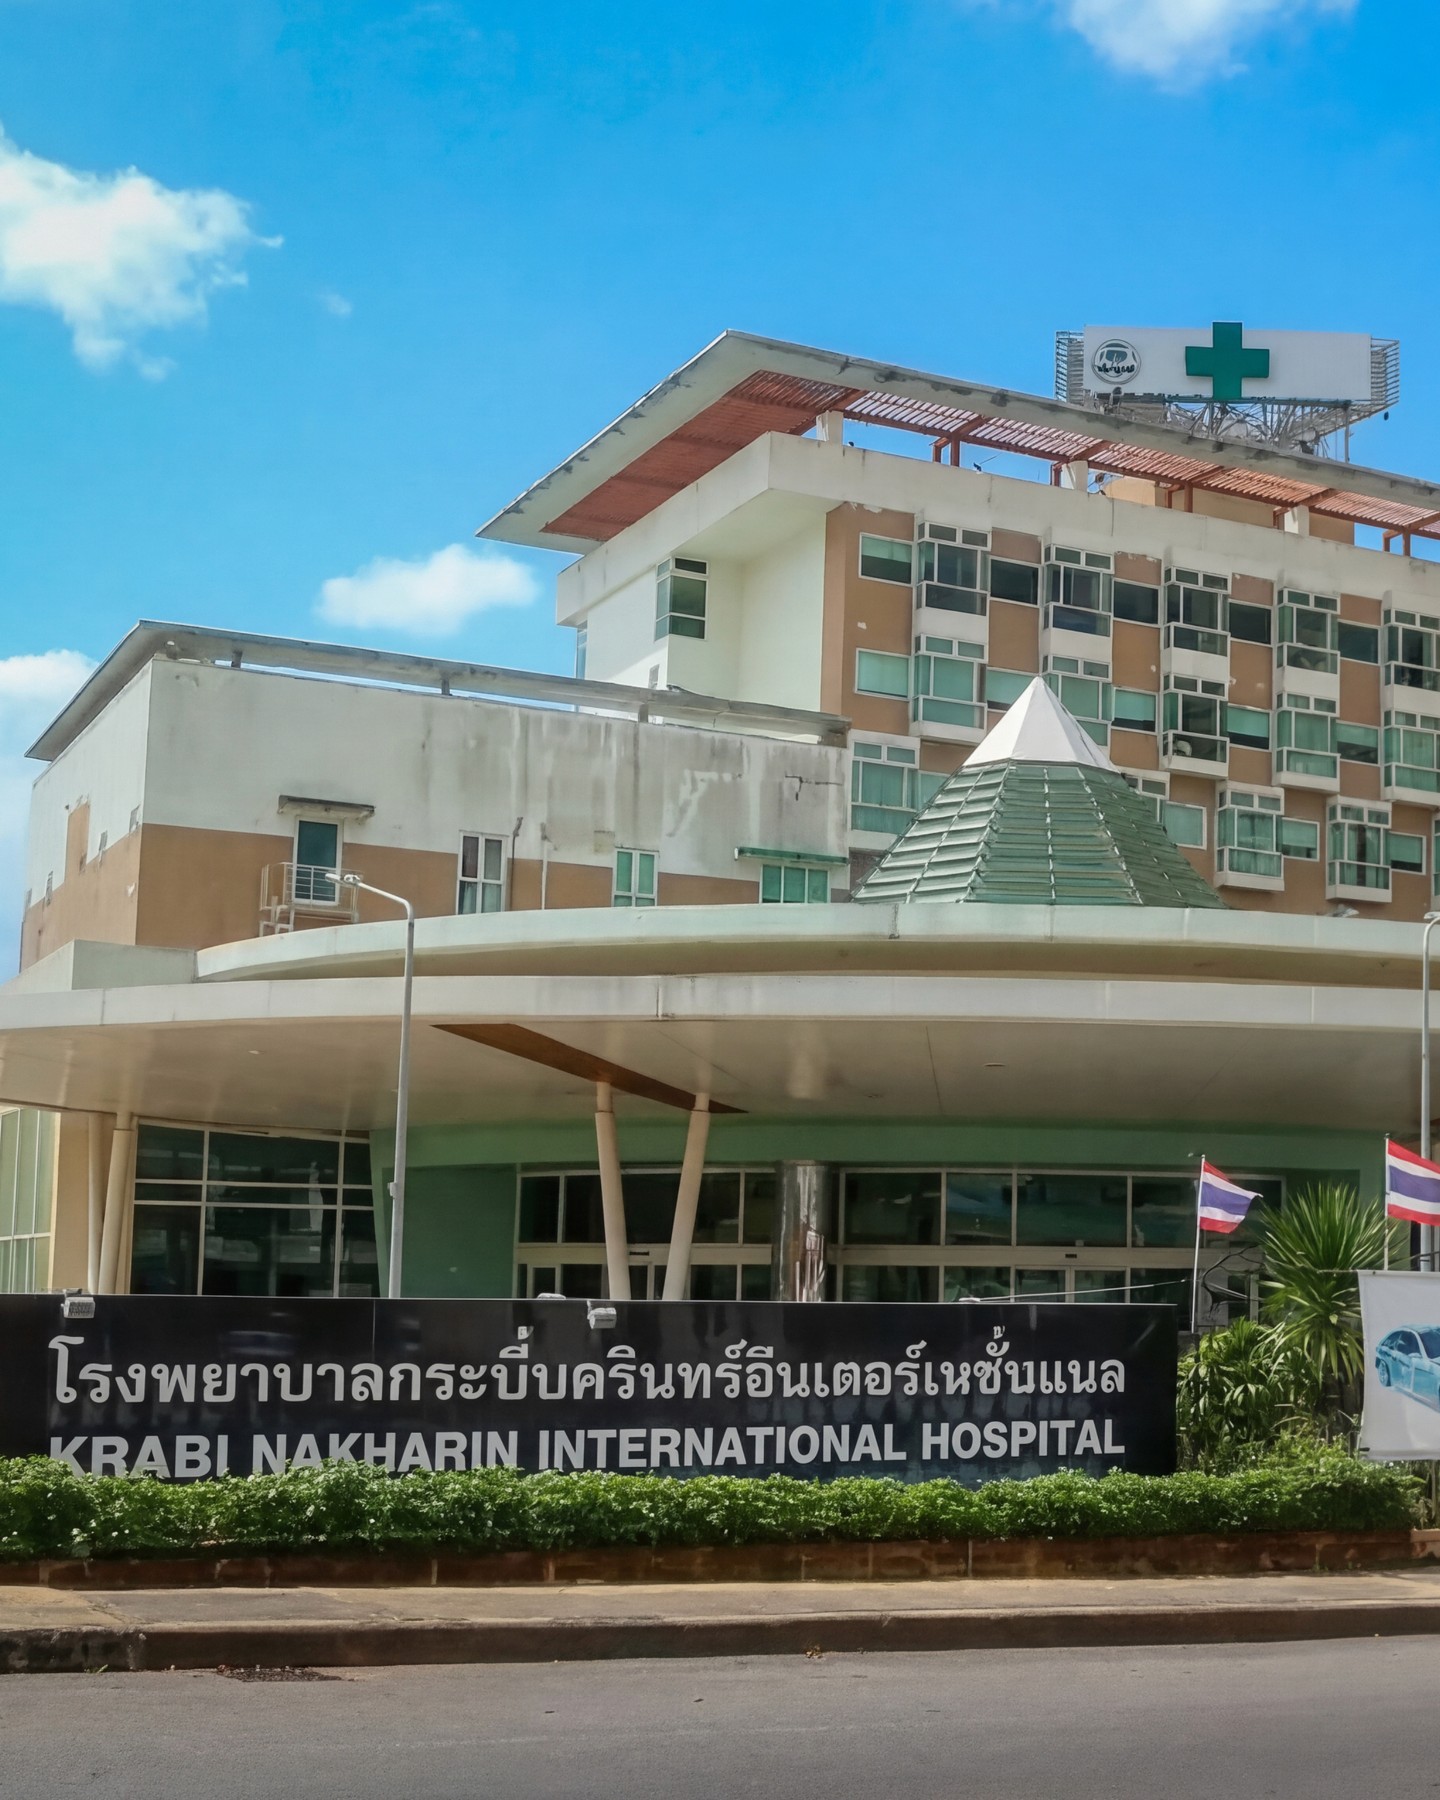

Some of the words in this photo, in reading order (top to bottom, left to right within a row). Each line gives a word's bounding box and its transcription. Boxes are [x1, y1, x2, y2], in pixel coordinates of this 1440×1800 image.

[49, 1434, 230, 1480] KRABI
[252, 1430, 519, 1476] NAKHARIN
[538, 1423, 907, 1472] INTERNATIONAL
[922, 1418, 1126, 1460] HOSPITAL
